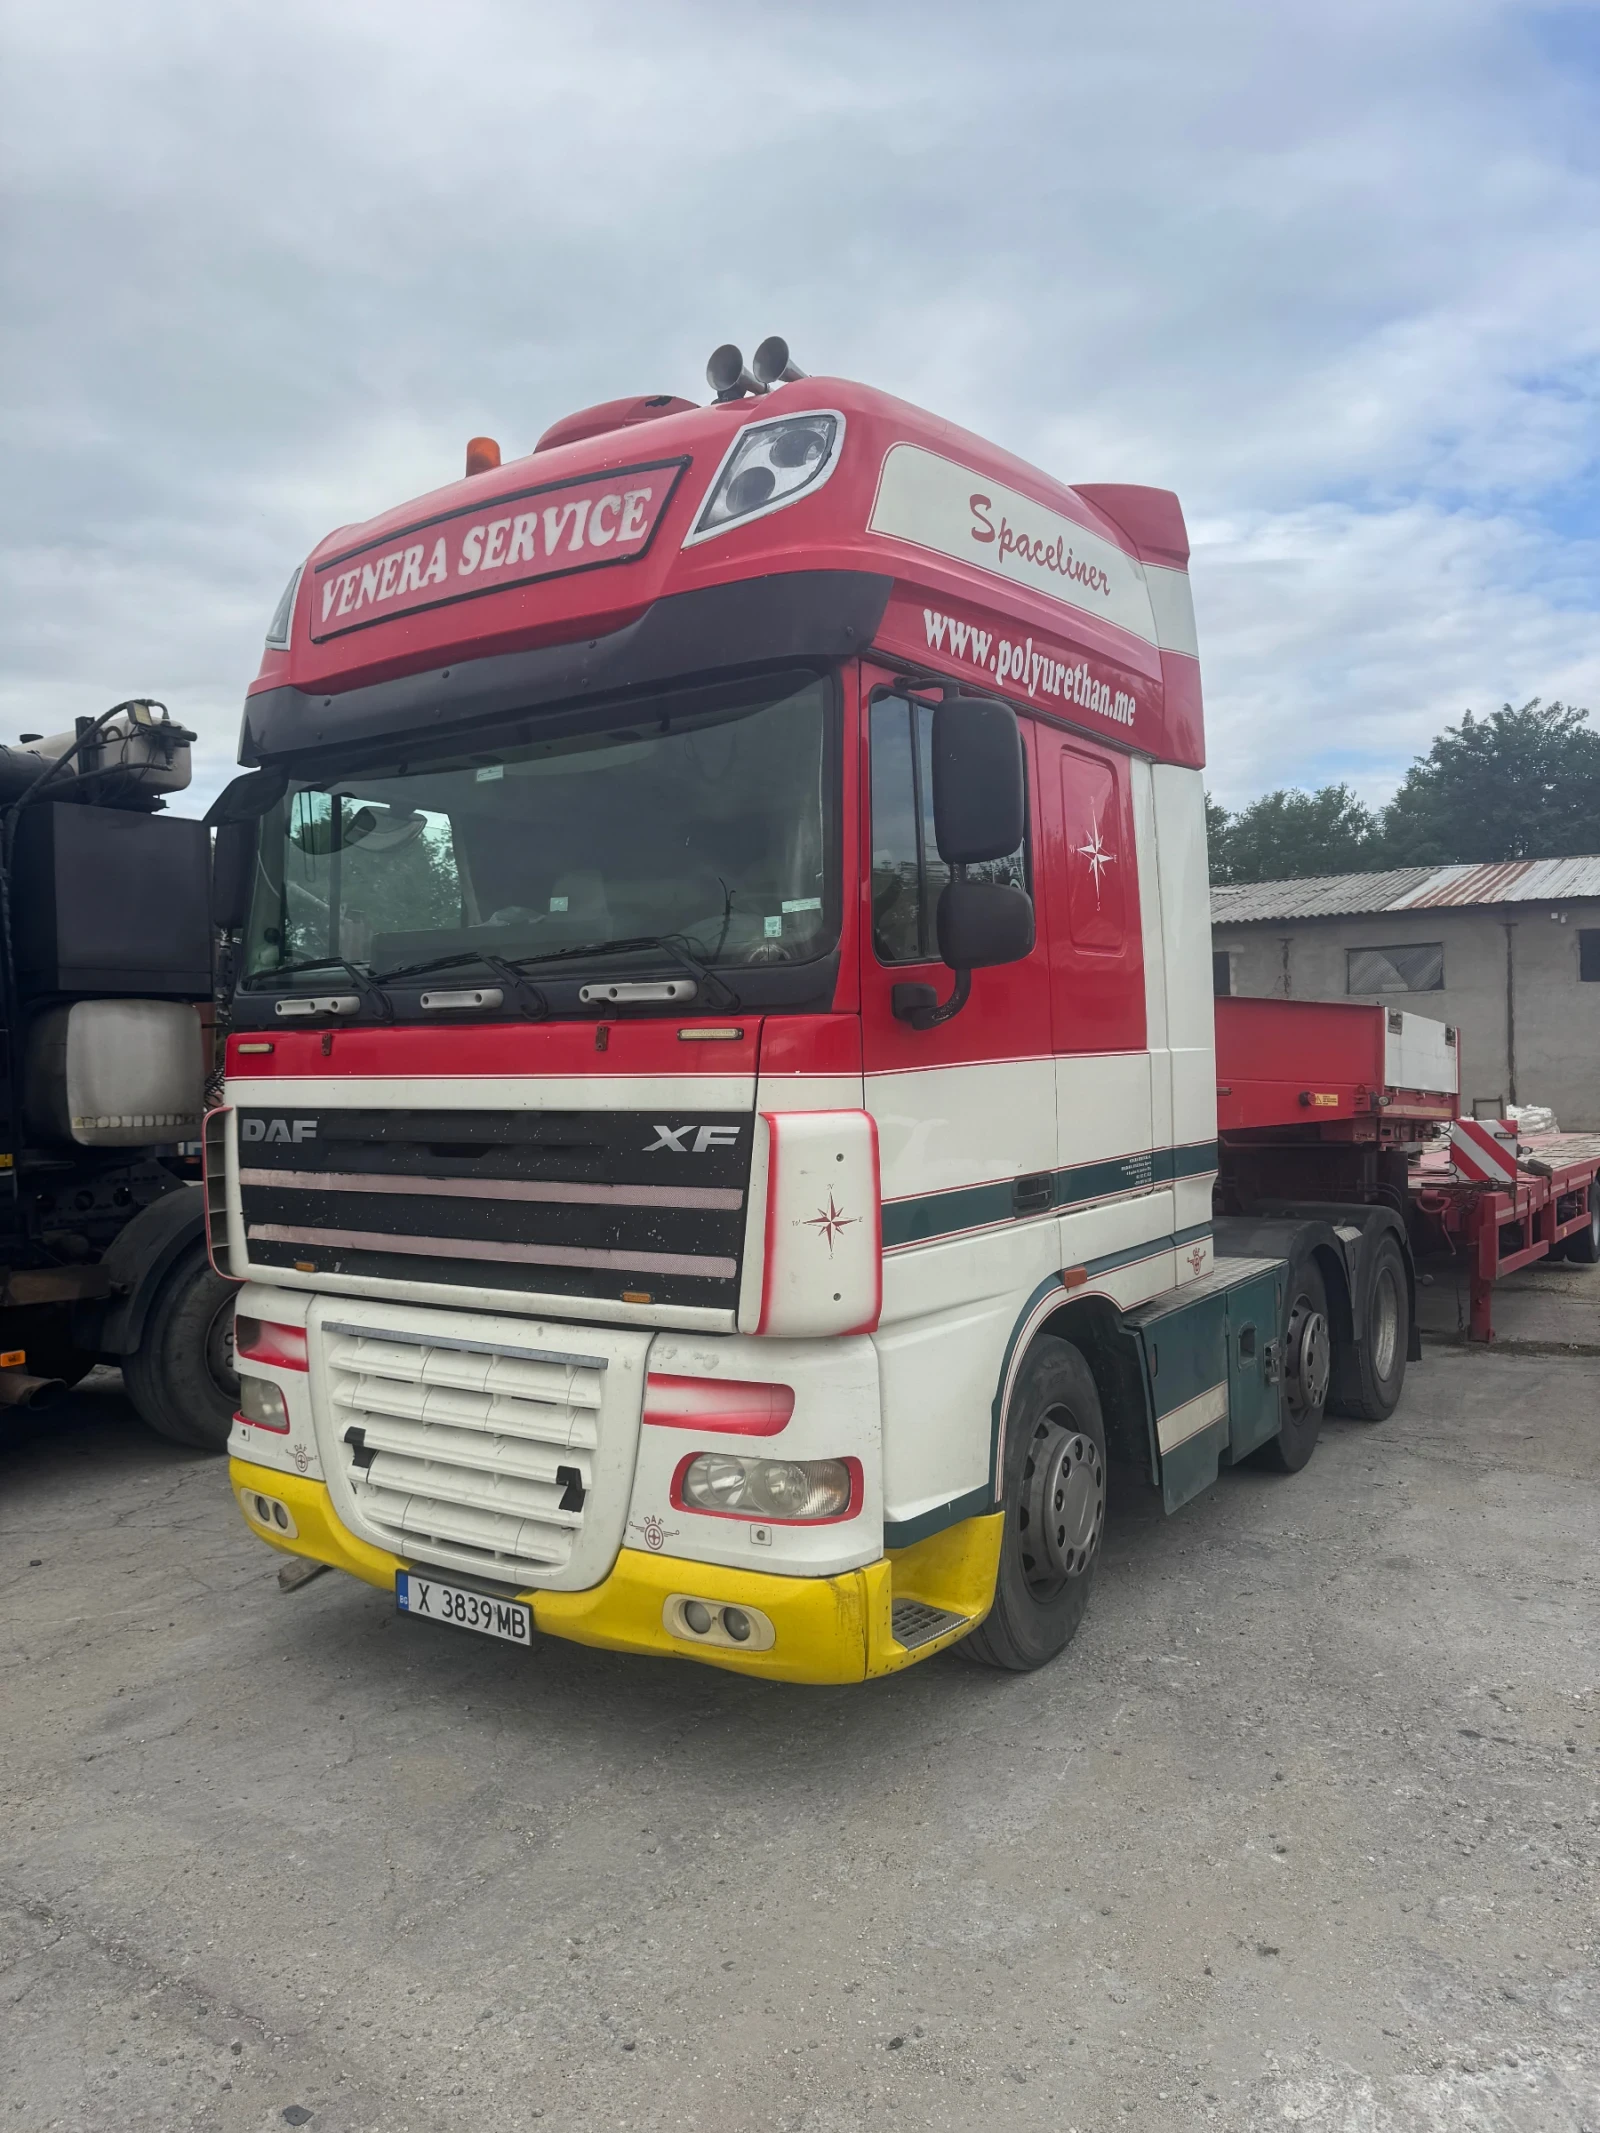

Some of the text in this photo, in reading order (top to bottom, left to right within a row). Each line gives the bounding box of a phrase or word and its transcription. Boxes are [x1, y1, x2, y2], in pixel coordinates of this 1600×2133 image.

[321, 487, 653, 622] VENERA SERVICE
[969, 494, 1110, 596] Spaceliner
[923, 608, 1136, 726] www.polyurethan.me
[242, 1119, 318, 1143] DAF
[641, 1125, 741, 1152] XF
[644, 1515, 664, 1525] DAF
[399, 1595, 408, 1604] BG
[418, 1582, 431, 1612] X
